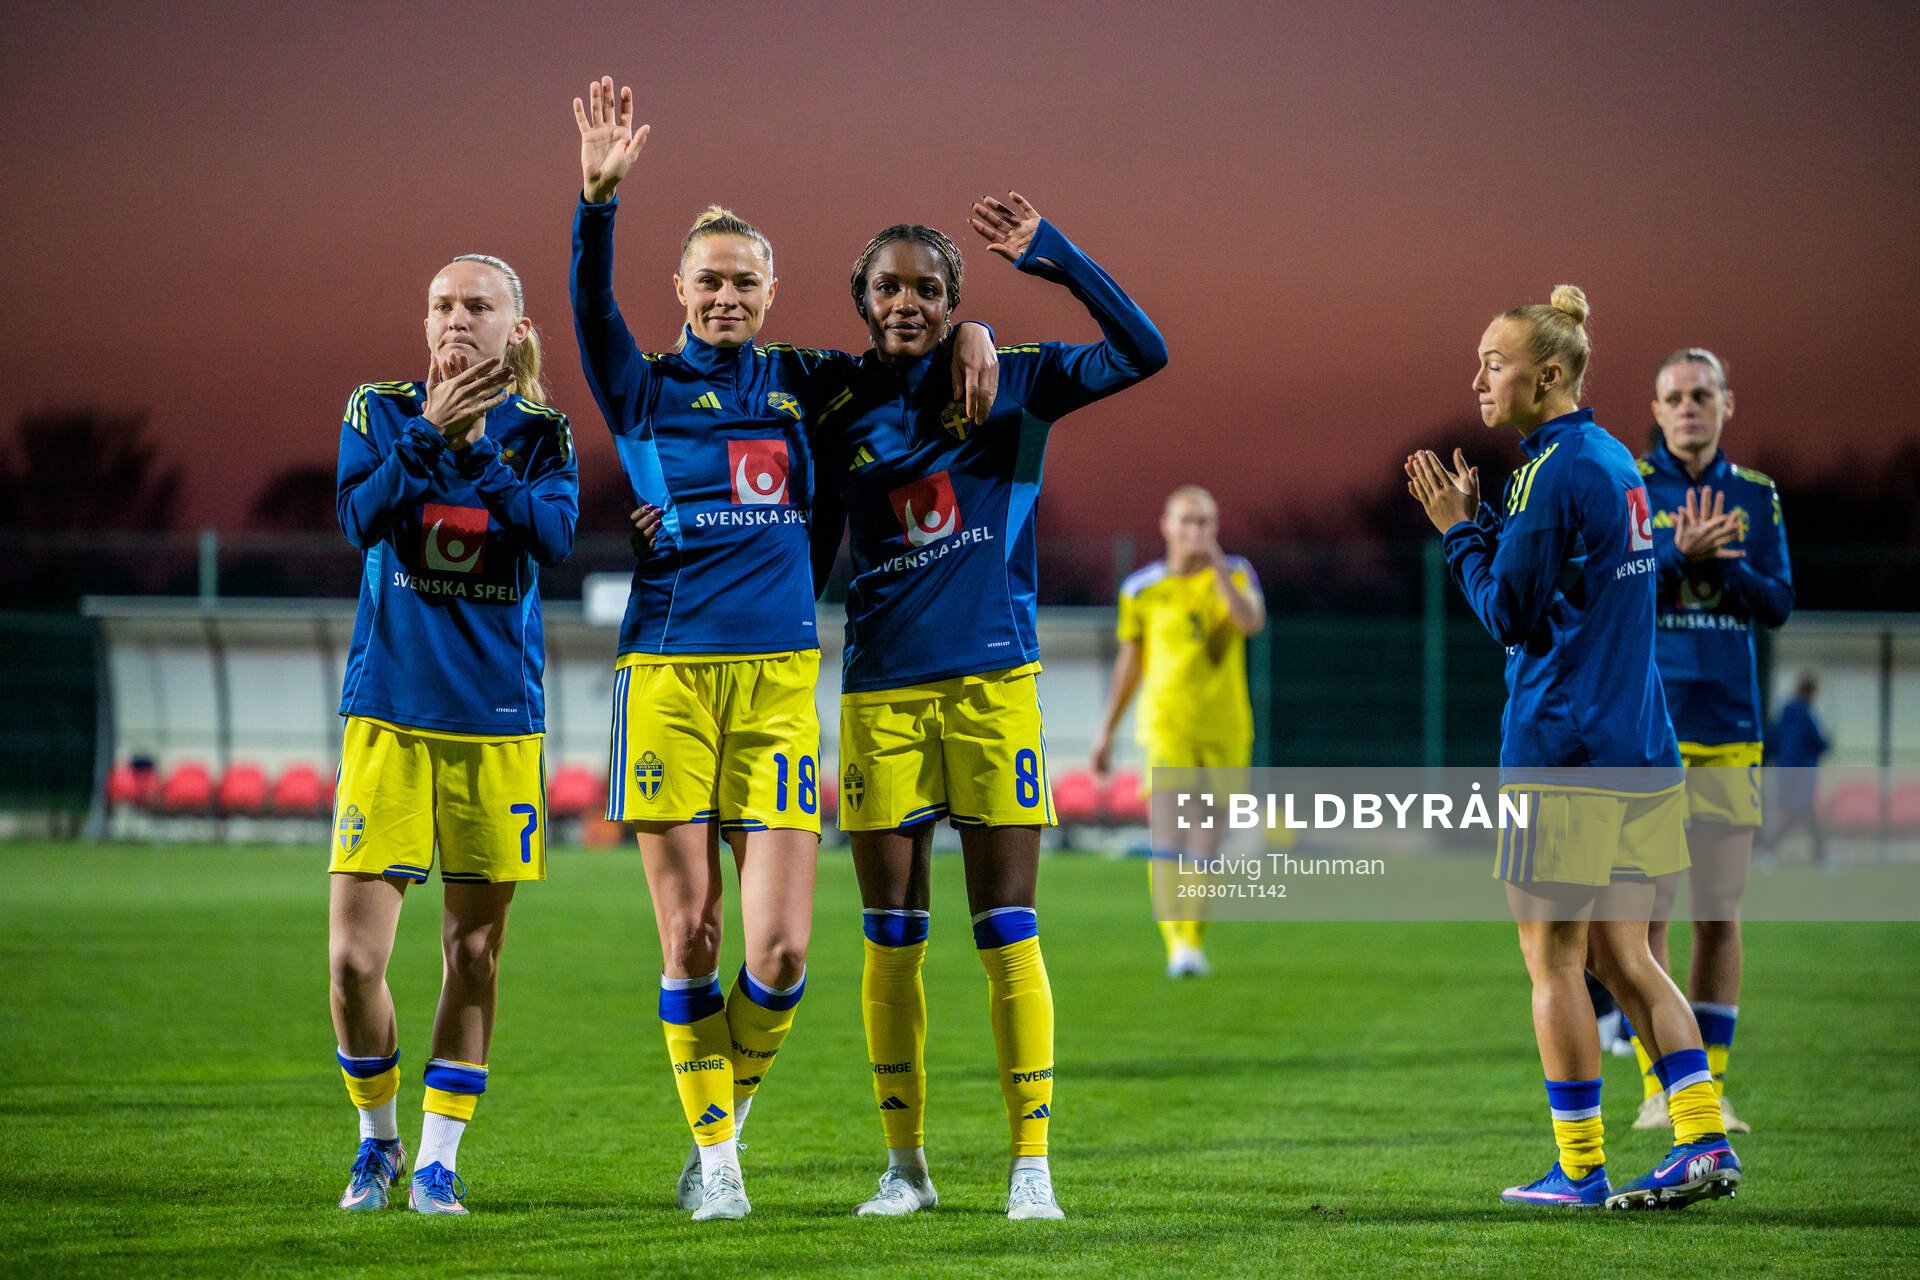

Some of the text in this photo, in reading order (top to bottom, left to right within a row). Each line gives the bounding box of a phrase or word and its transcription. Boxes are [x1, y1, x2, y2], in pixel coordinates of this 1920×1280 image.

[695, 509, 808, 528] SVENSKA SPE
[393, 571, 517, 601] SVENSKA SPEL
[773, 752, 816, 814] 18
[1015, 748, 1040, 808] 8
[510, 803, 537, 863] 7
[674, 1059, 725, 1075] SVERIGE
[870, 1062, 912, 1075] VERIGE
